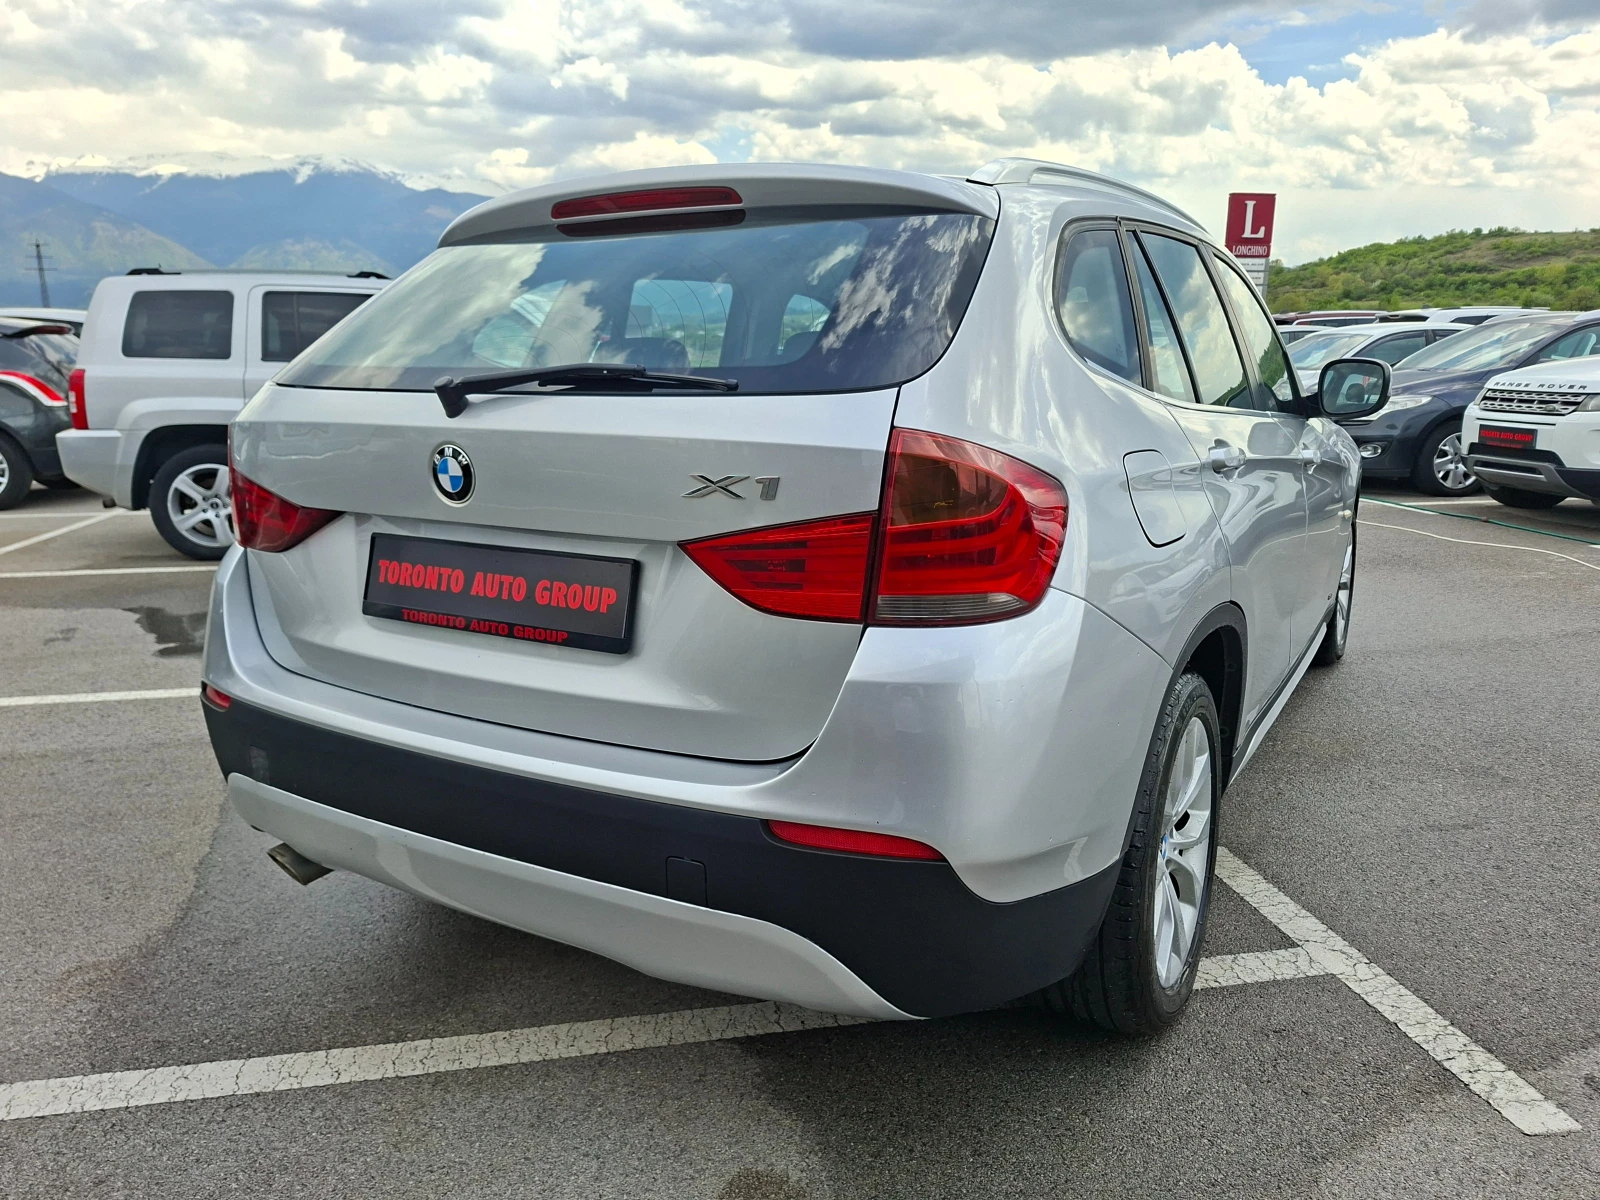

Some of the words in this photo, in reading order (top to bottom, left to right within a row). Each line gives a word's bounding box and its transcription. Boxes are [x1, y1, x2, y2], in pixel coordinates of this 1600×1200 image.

[1241, 200, 1266, 238] L
[1232, 245, 1268, 256] LONGHINO
[1537, 383, 1588, 391] ROVER
[434, 447, 469, 466] BMW
[680, 473, 781, 501] X1
[378, 559, 465, 593] TORONTO
[471, 571, 527, 602] AUTO
[535, 579, 617, 614] GROUP
[402, 609, 465, 629] TORONTO
[469, 619, 509, 636] AUTO
[513, 627, 568, 643] GROUP
